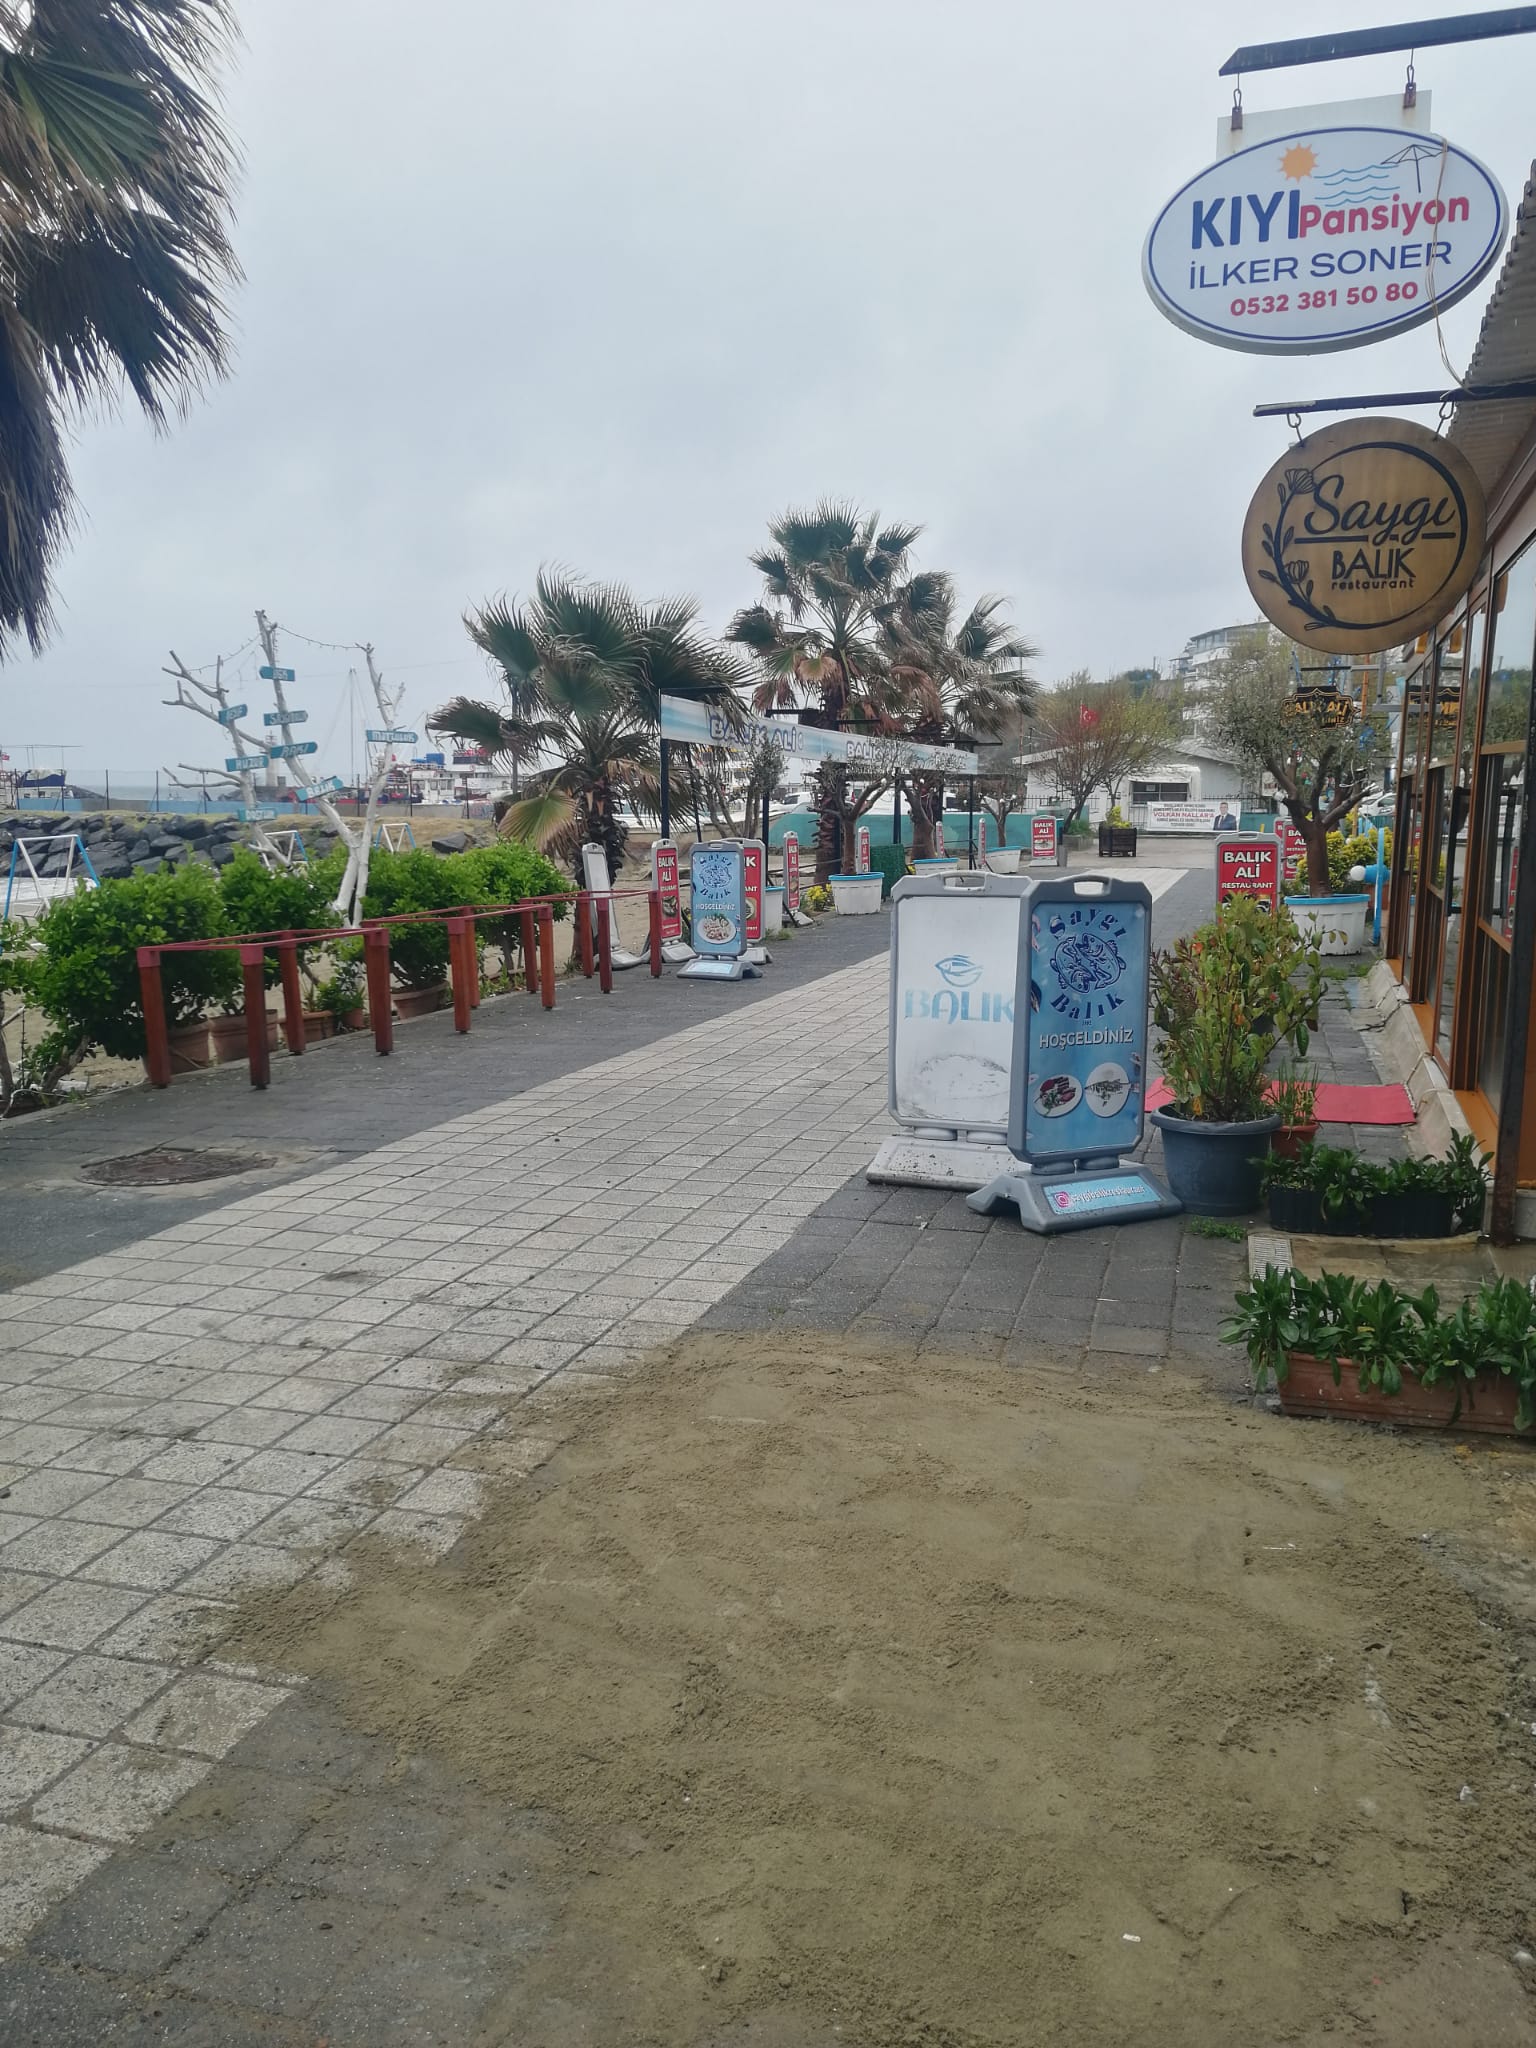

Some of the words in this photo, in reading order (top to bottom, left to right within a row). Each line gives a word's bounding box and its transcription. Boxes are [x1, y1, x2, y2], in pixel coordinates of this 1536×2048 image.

[1191, 189, 1300, 249] KIYI
[1299, 193, 1470, 238] Pansiyon
[1190, 256, 1298, 290] İLKER
[1310, 241, 1452, 278] SONER
[1230, 294, 1289, 317] 0532
[1297, 288, 1338, 311] 381
[1346, 285, 1378, 305] 50
[1385, 281, 1418, 301] 80
[1303, 474, 1456, 546] Saygı
[1331, 548, 1417, 580] BALIK
[1331, 578, 1416, 590] restaurant
[658, 856, 675, 868] BALIK
[1223, 851, 1272, 863] BALIK
[1235, 864, 1260, 878] ALİ
[904, 989, 1014, 1024] BALIK
[1050, 993, 1126, 1020] Balık
[1039, 1026, 1134, 1051] HOŞGELDİNİZ
